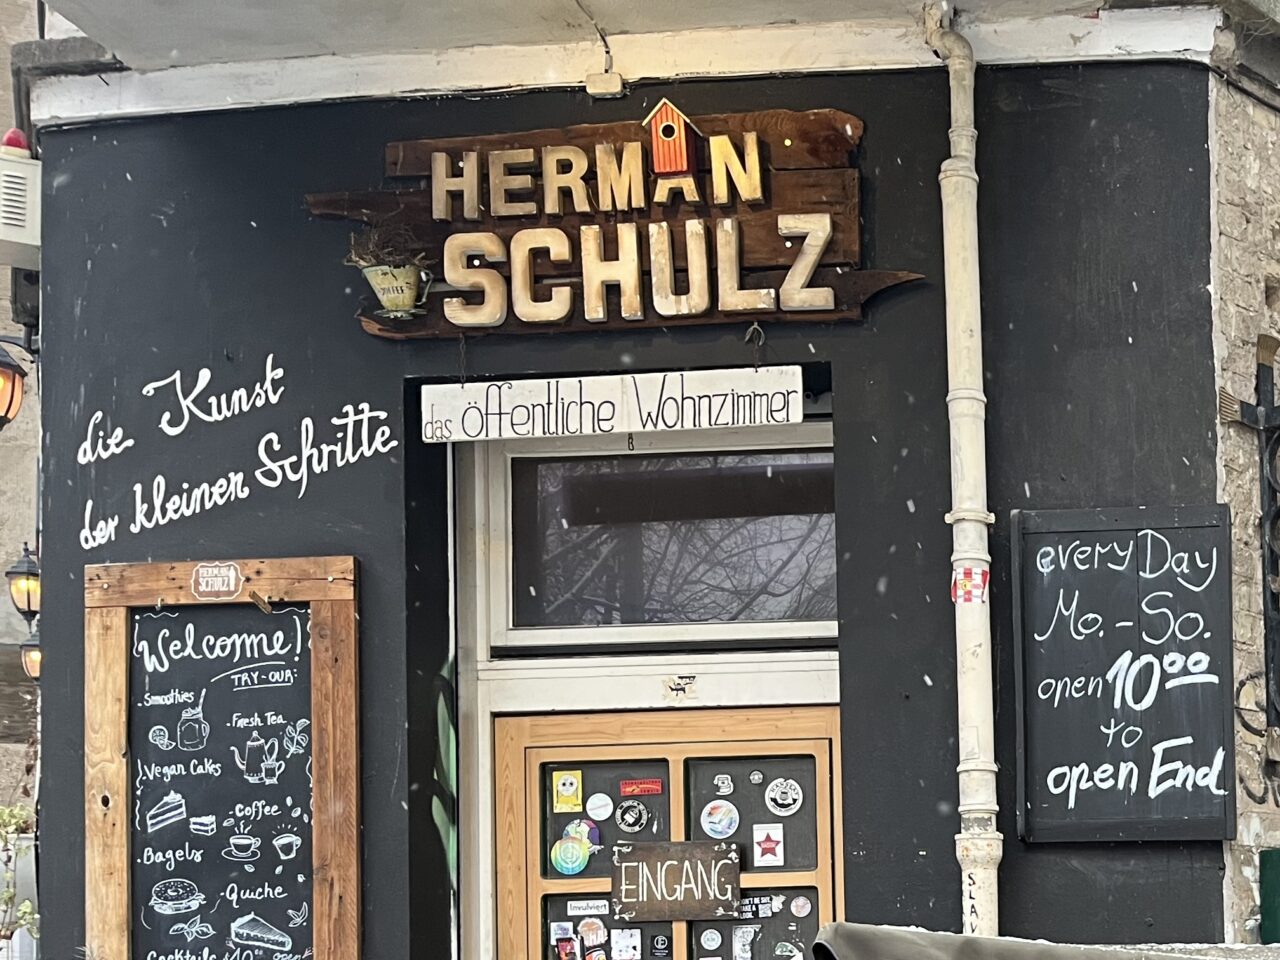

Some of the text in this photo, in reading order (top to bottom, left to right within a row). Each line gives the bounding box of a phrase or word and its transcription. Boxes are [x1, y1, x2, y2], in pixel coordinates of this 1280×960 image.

[443, 213, 835, 327] SCHULZ
[77, 353, 284, 465] die Kunst
[424, 374, 799, 442] das öffentliche Wohnzimmer
[79, 402, 399, 550] der kleinen Schritte
[1036, 529, 1218, 592] every Day
[139, 615, 302, 673] Welcome!
[143, 688, 195, 707] Smoothies
[1037, 675, 1103, 709] open
[265, 711, 288, 726] Tea
[1100, 718, 1143, 748] to
[145, 759, 223, 782] Vegan Cakes
[1047, 736, 1230, 810] open End
[234, 800, 282, 820] Coffee
[143, 842, 204, 871] Bagels
[225, 883, 288, 909] Quiche
[620, 860, 733, 903] EINGANG
